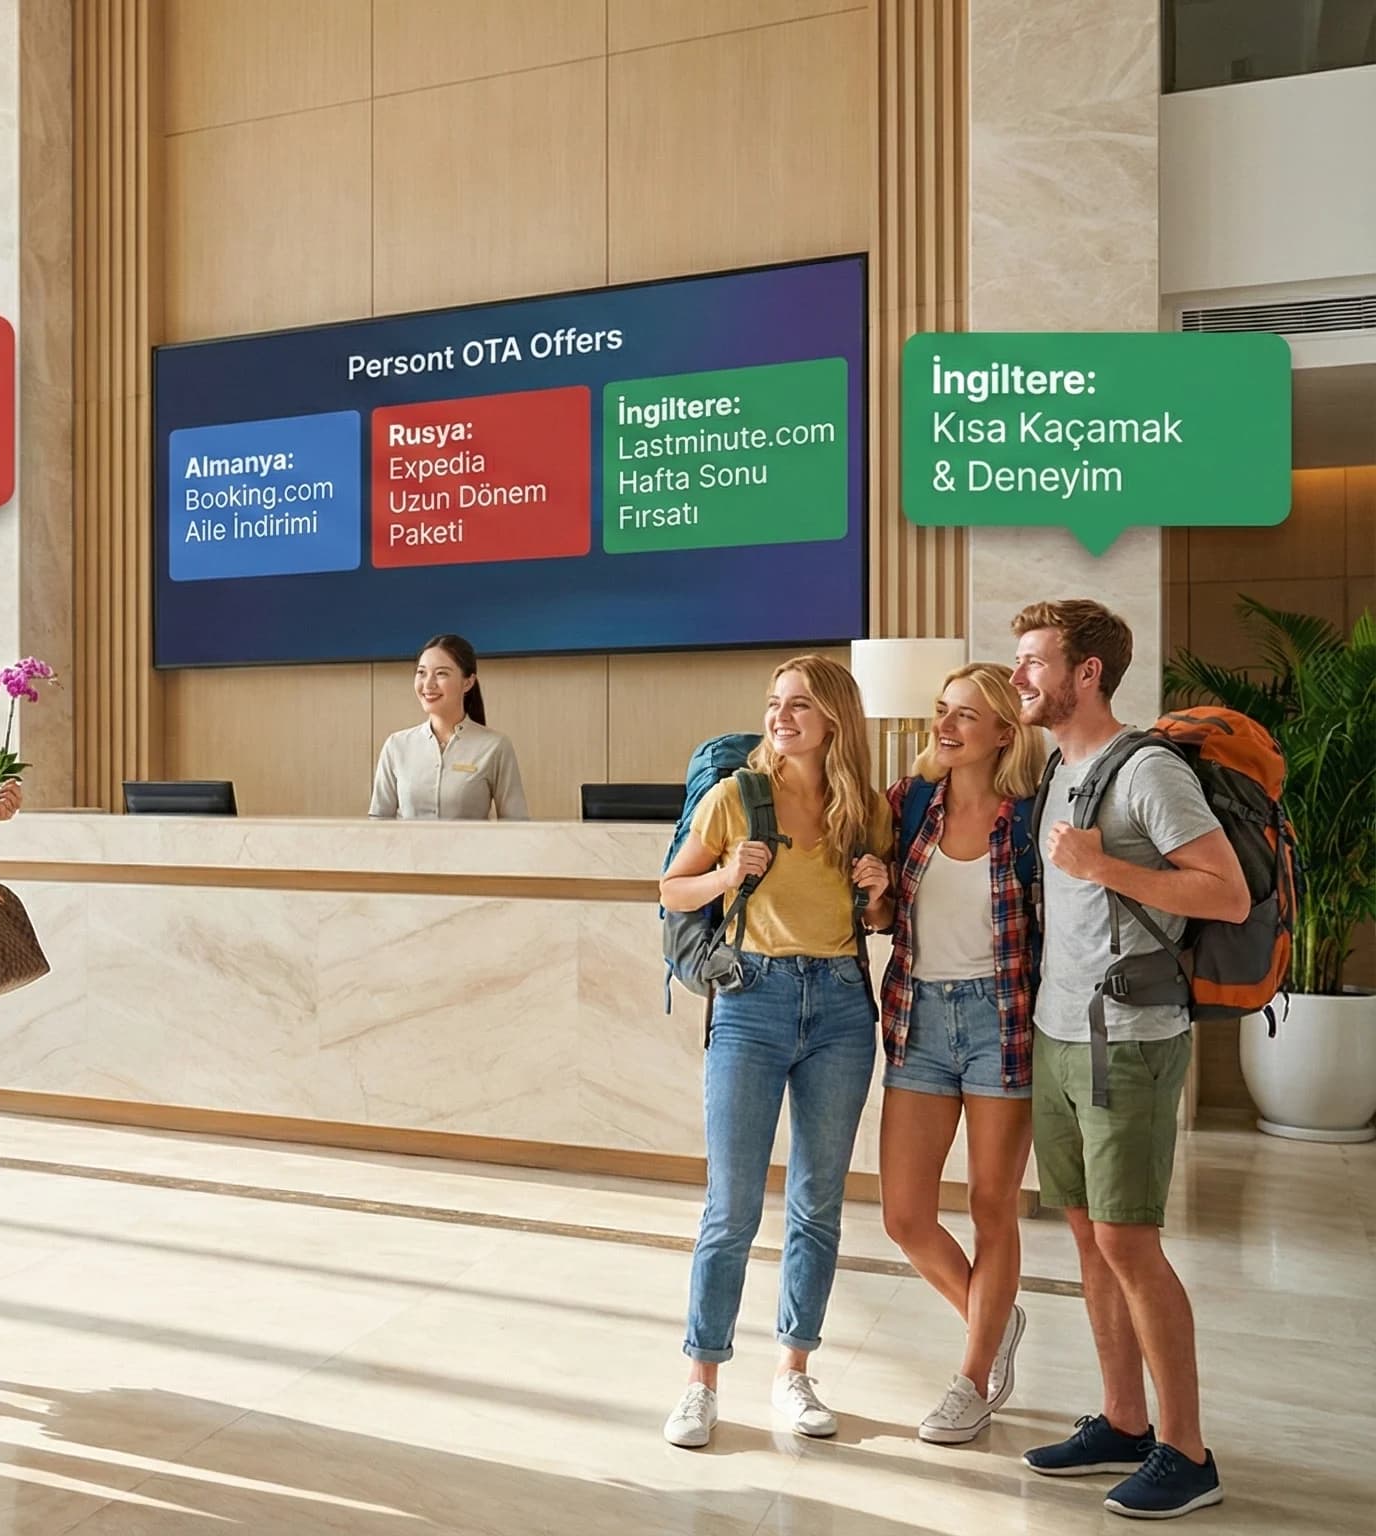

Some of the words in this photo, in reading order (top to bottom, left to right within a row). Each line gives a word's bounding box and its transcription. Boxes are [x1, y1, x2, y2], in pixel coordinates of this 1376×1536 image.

[349, 347, 454, 379] Persont
[462, 337, 522, 367] OTA
[530, 328, 623, 358] Offers
[619, 395, 740, 428] İngiltere:
[389, 422, 473, 448] Rusya:
[619, 423, 835, 460] Lastminute.com
[185, 453, 294, 479] Almanya:
[390, 452, 485, 483] Expedia
[619, 468, 690, 495] Hafta
[699, 464, 767, 488] Sonu
[186, 481, 333, 511] Booking.com
[390, 491, 450, 513] Uzun
[459, 483, 546, 508] Dönem
[185, 519, 226, 543] Aile
[233, 510, 317, 539] İndirimi
[619, 502, 698, 529] Fırsatı
[390, 520, 463, 546] Paketi
